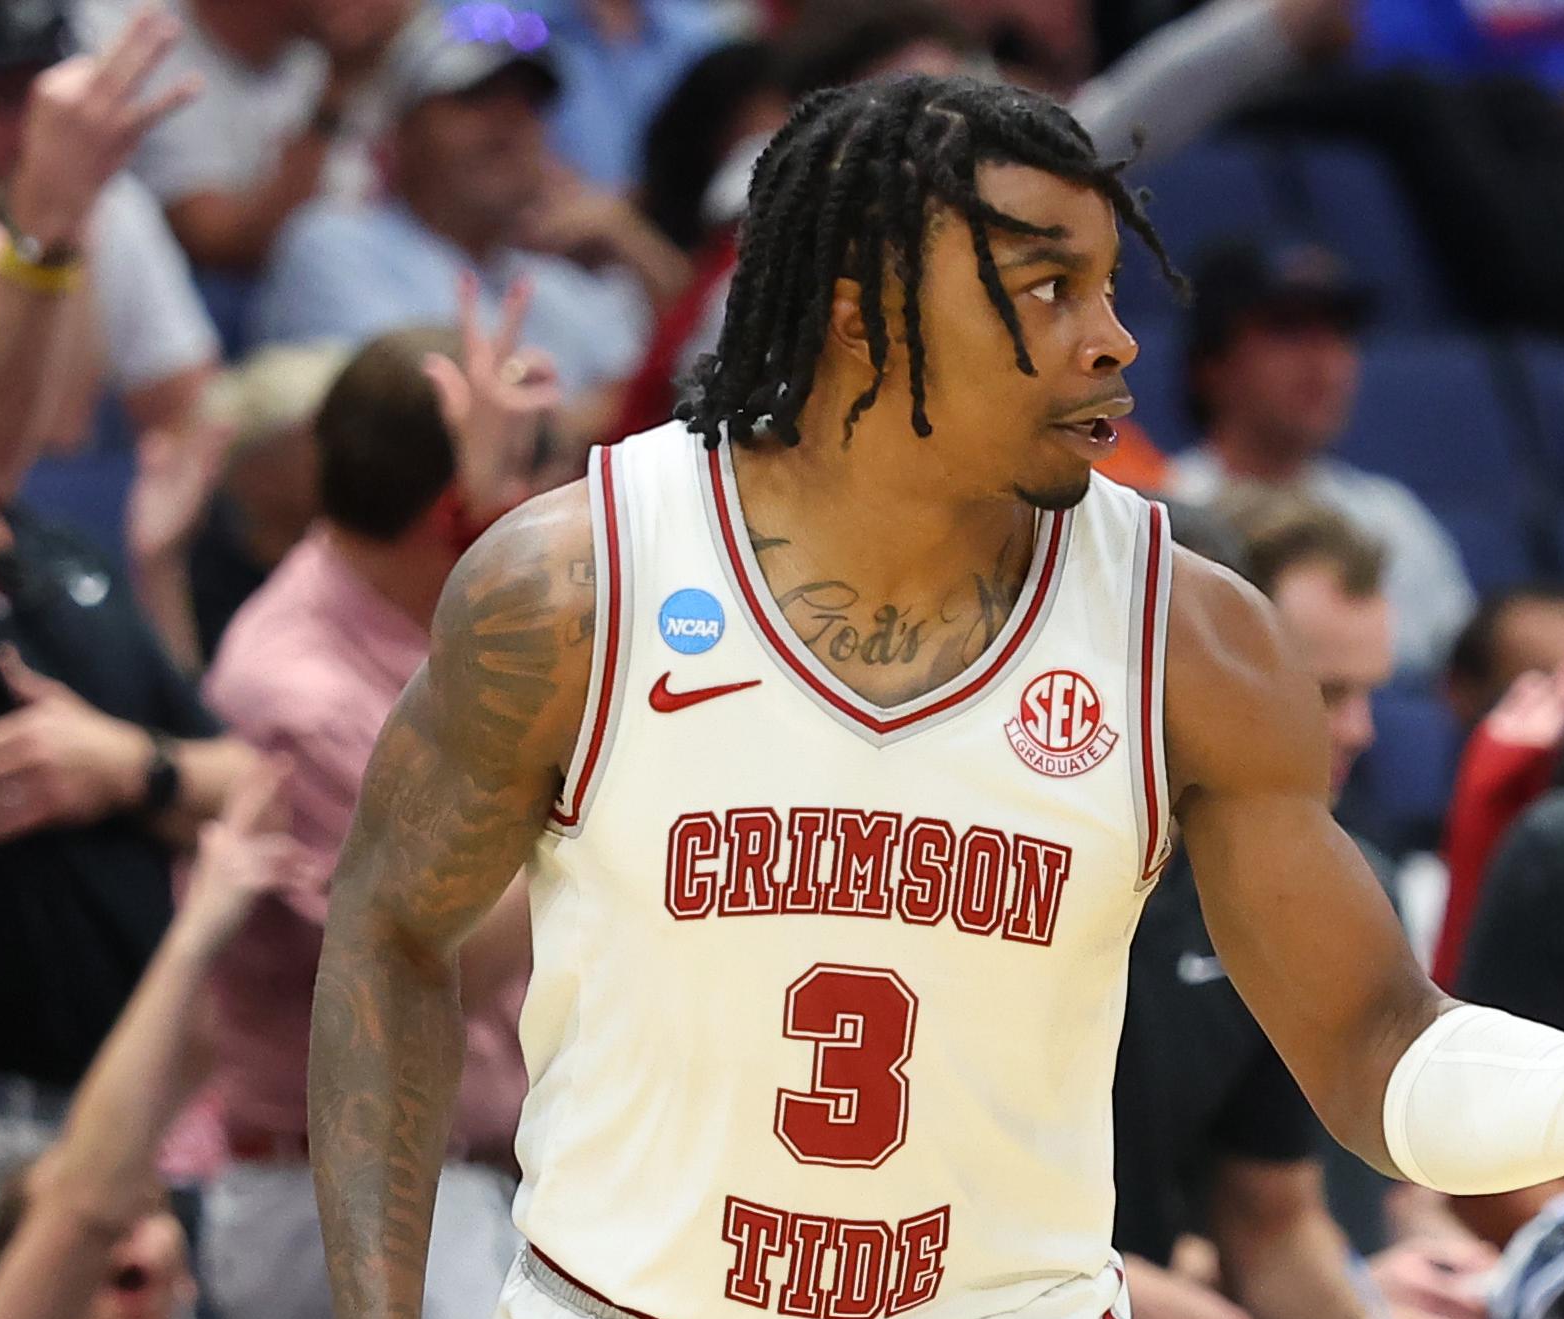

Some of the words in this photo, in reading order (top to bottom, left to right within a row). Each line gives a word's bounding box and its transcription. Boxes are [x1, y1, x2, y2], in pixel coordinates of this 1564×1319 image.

[665, 616, 720, 638] NCAA
[1024, 673, 1097, 749] SEC
[1015, 739, 1102, 774] GRADUATE
[664, 807, 1072, 946] CRIMSON
[773, 962, 919, 1170] 3
